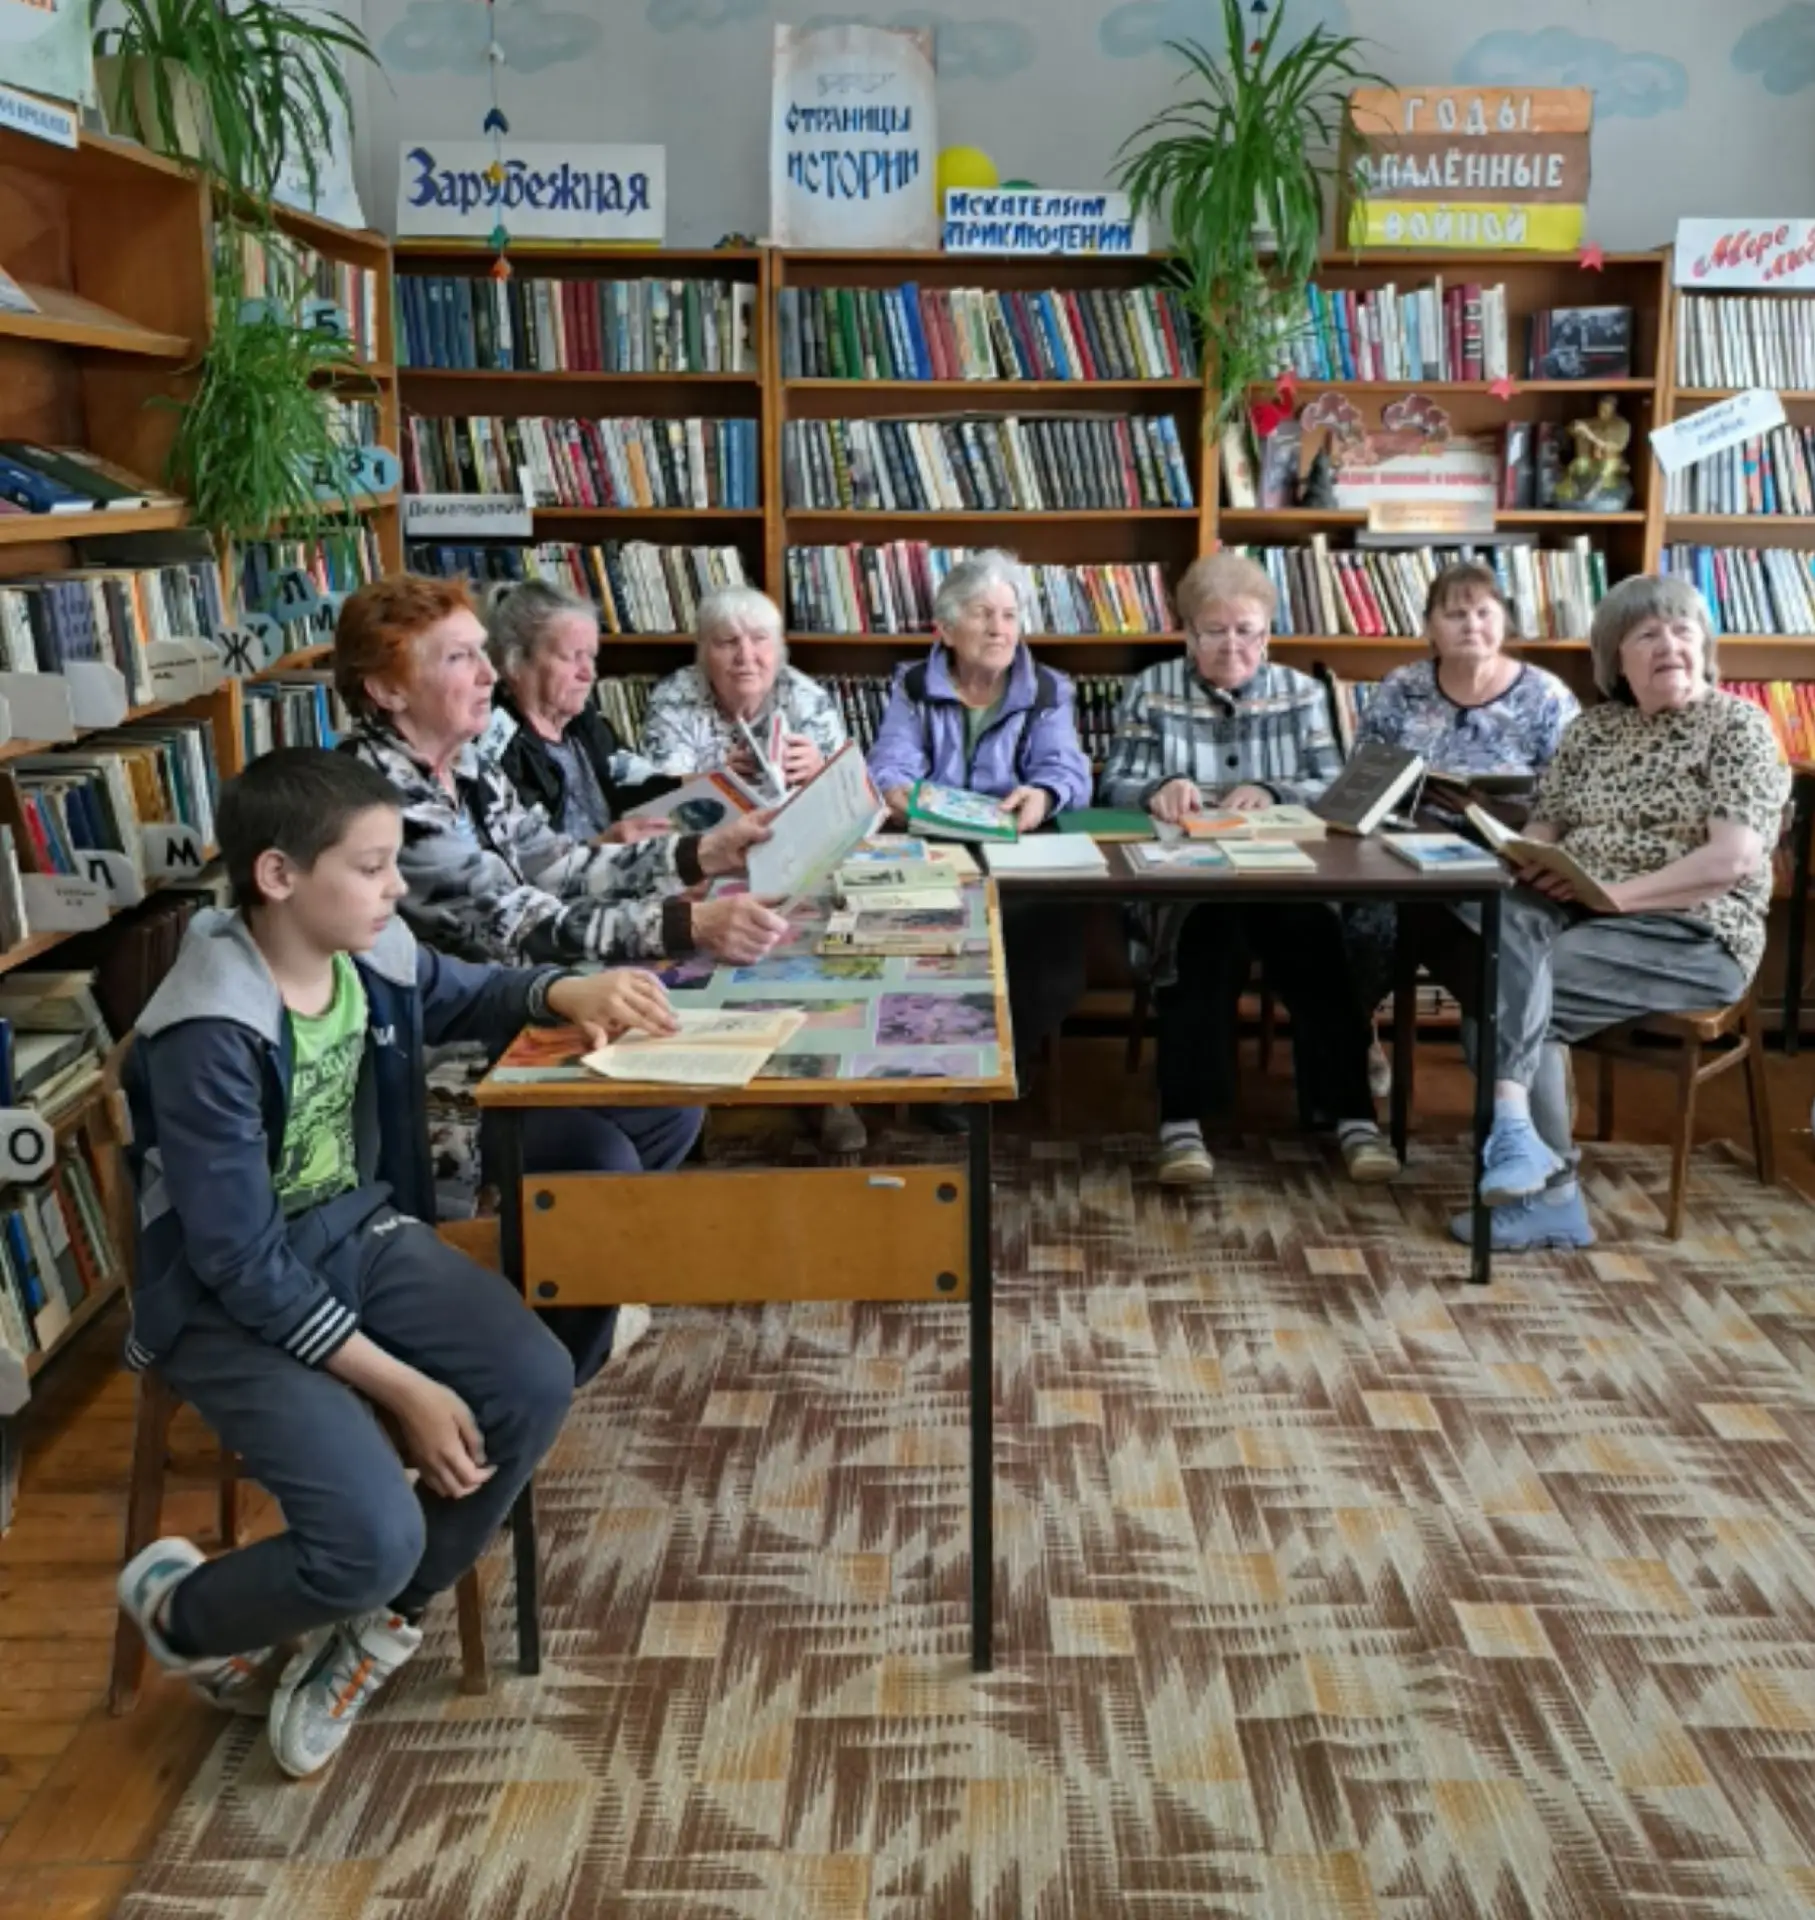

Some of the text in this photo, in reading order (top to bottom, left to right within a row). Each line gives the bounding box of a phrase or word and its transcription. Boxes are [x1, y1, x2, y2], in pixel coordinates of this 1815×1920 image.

[785, 101, 912, 135] СТРАНИЦЫ
[406, 147, 651, 215] Зарубежная
[788, 149, 919, 200] ИСТОРИИ
[1384, 202, 1528, 244] ВОЙНОЙ
[218, 632, 256, 674] Ж
[166, 837, 200, 867] М
[8, 1127, 45, 1165] О
